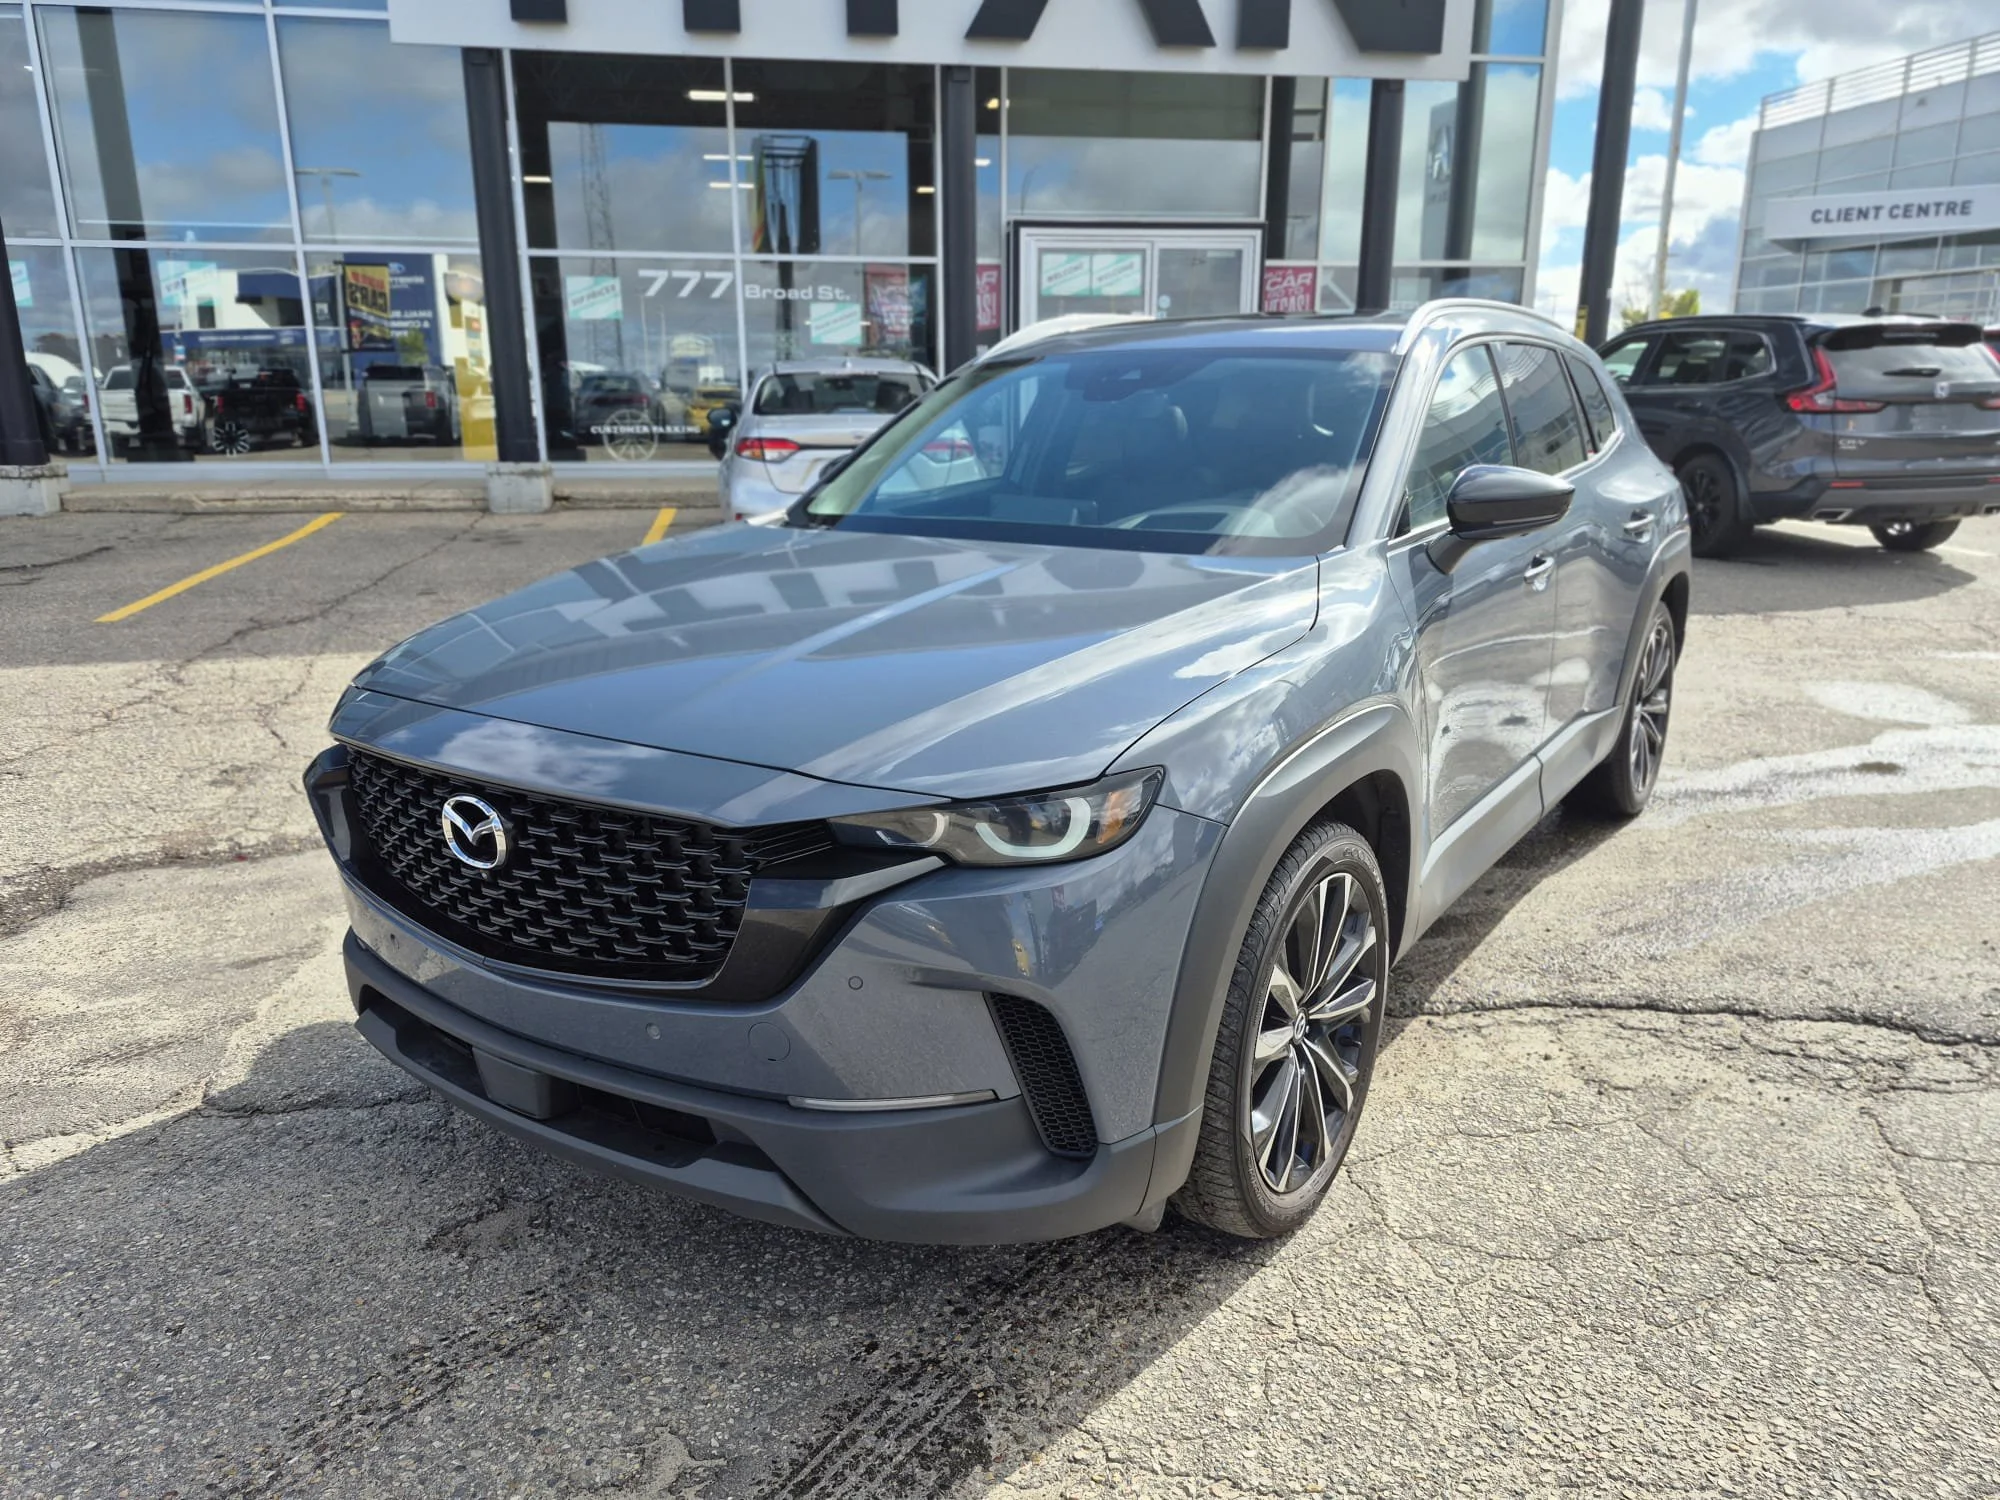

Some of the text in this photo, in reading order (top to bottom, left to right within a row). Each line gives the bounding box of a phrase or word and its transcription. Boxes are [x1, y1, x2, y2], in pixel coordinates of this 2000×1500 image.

[1810, 199, 1973, 224] CLIENT CENTRE
[637, 269, 851, 300] 777 Broad St.
[1265, 272, 1313, 291] CAR
[590, 425, 702, 434] CUSTOMER PARKING
